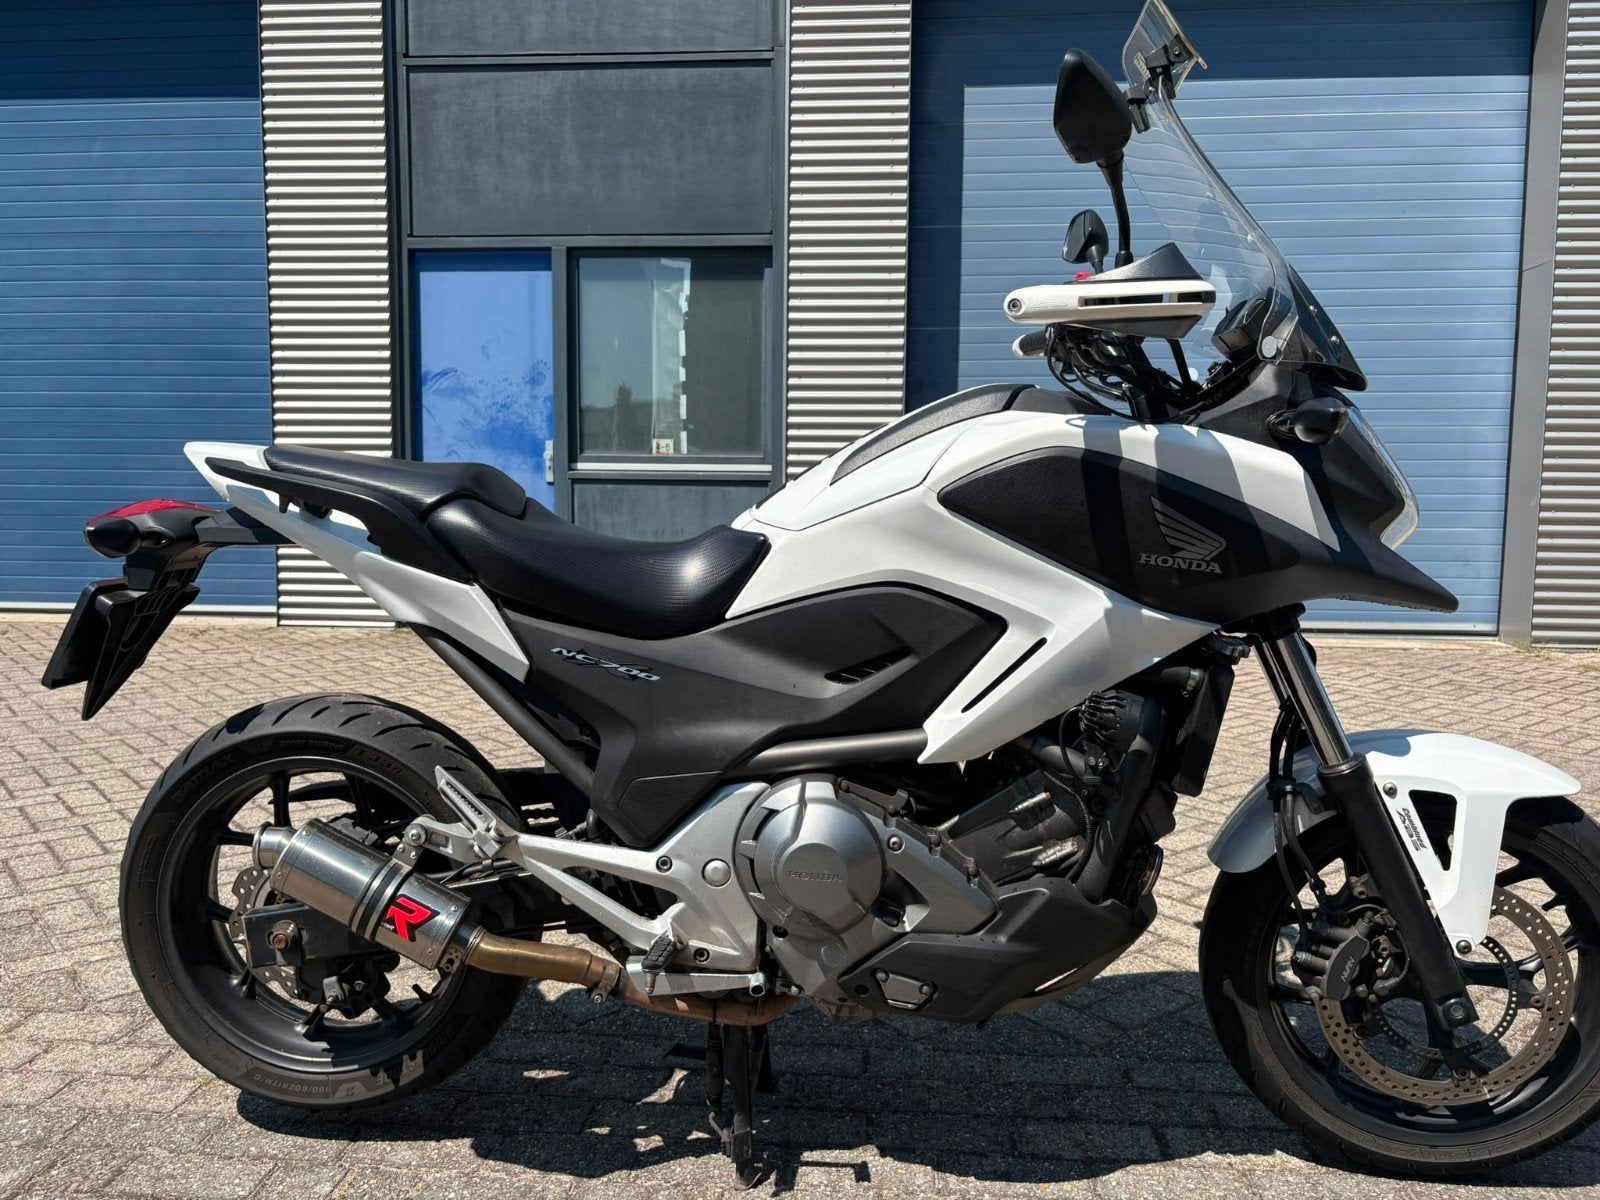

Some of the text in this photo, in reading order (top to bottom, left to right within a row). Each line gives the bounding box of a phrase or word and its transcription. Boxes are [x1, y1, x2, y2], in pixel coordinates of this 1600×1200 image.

[1138, 553, 1223, 574] HONDA
[550, 647, 661, 681] NC700
[787, 870, 843, 882] HONDA
